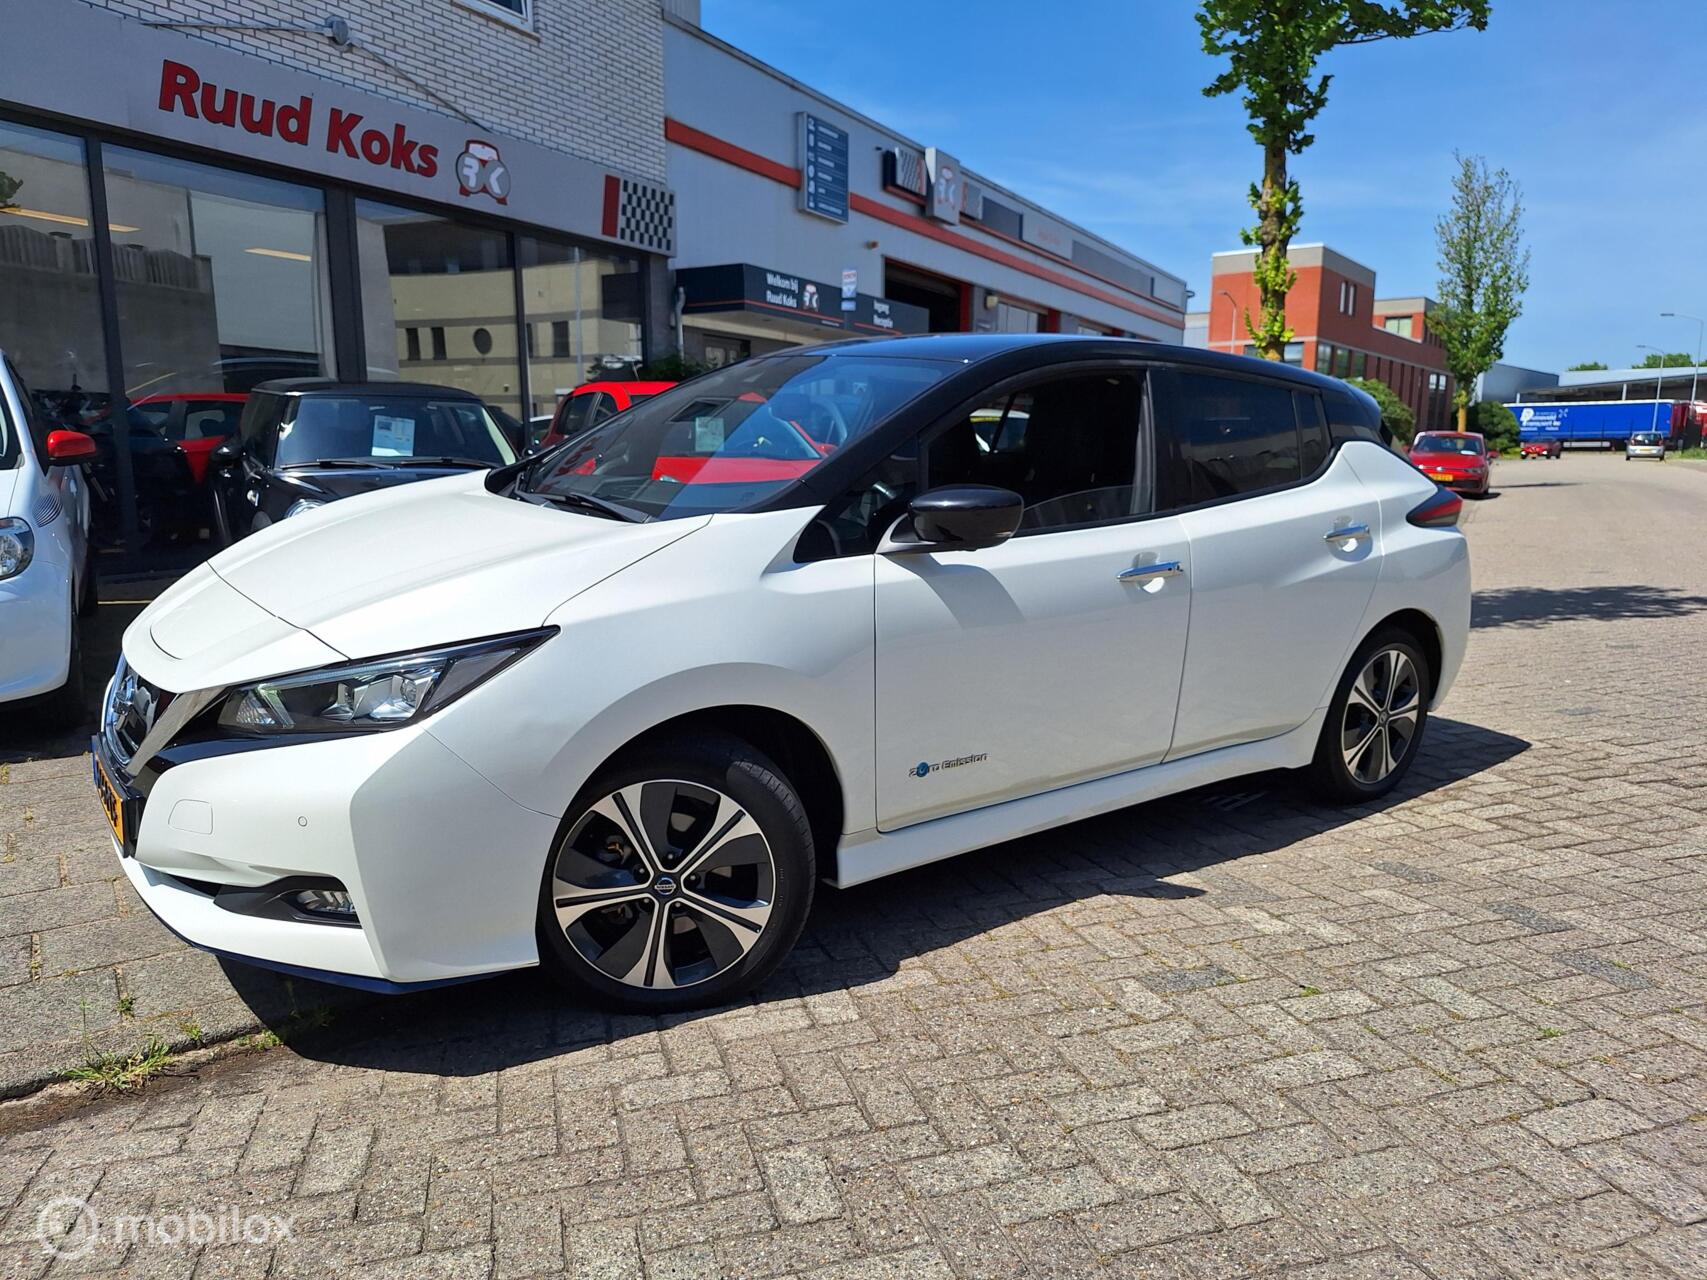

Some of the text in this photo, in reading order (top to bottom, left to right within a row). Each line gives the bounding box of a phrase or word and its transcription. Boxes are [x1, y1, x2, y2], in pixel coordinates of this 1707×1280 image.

[158, 59, 439, 178] Ruud Koks
[766, 272, 790, 290] Welkom
[766, 290, 798, 308] Ruud Koks
[941, 753, 988, 770] Emission
